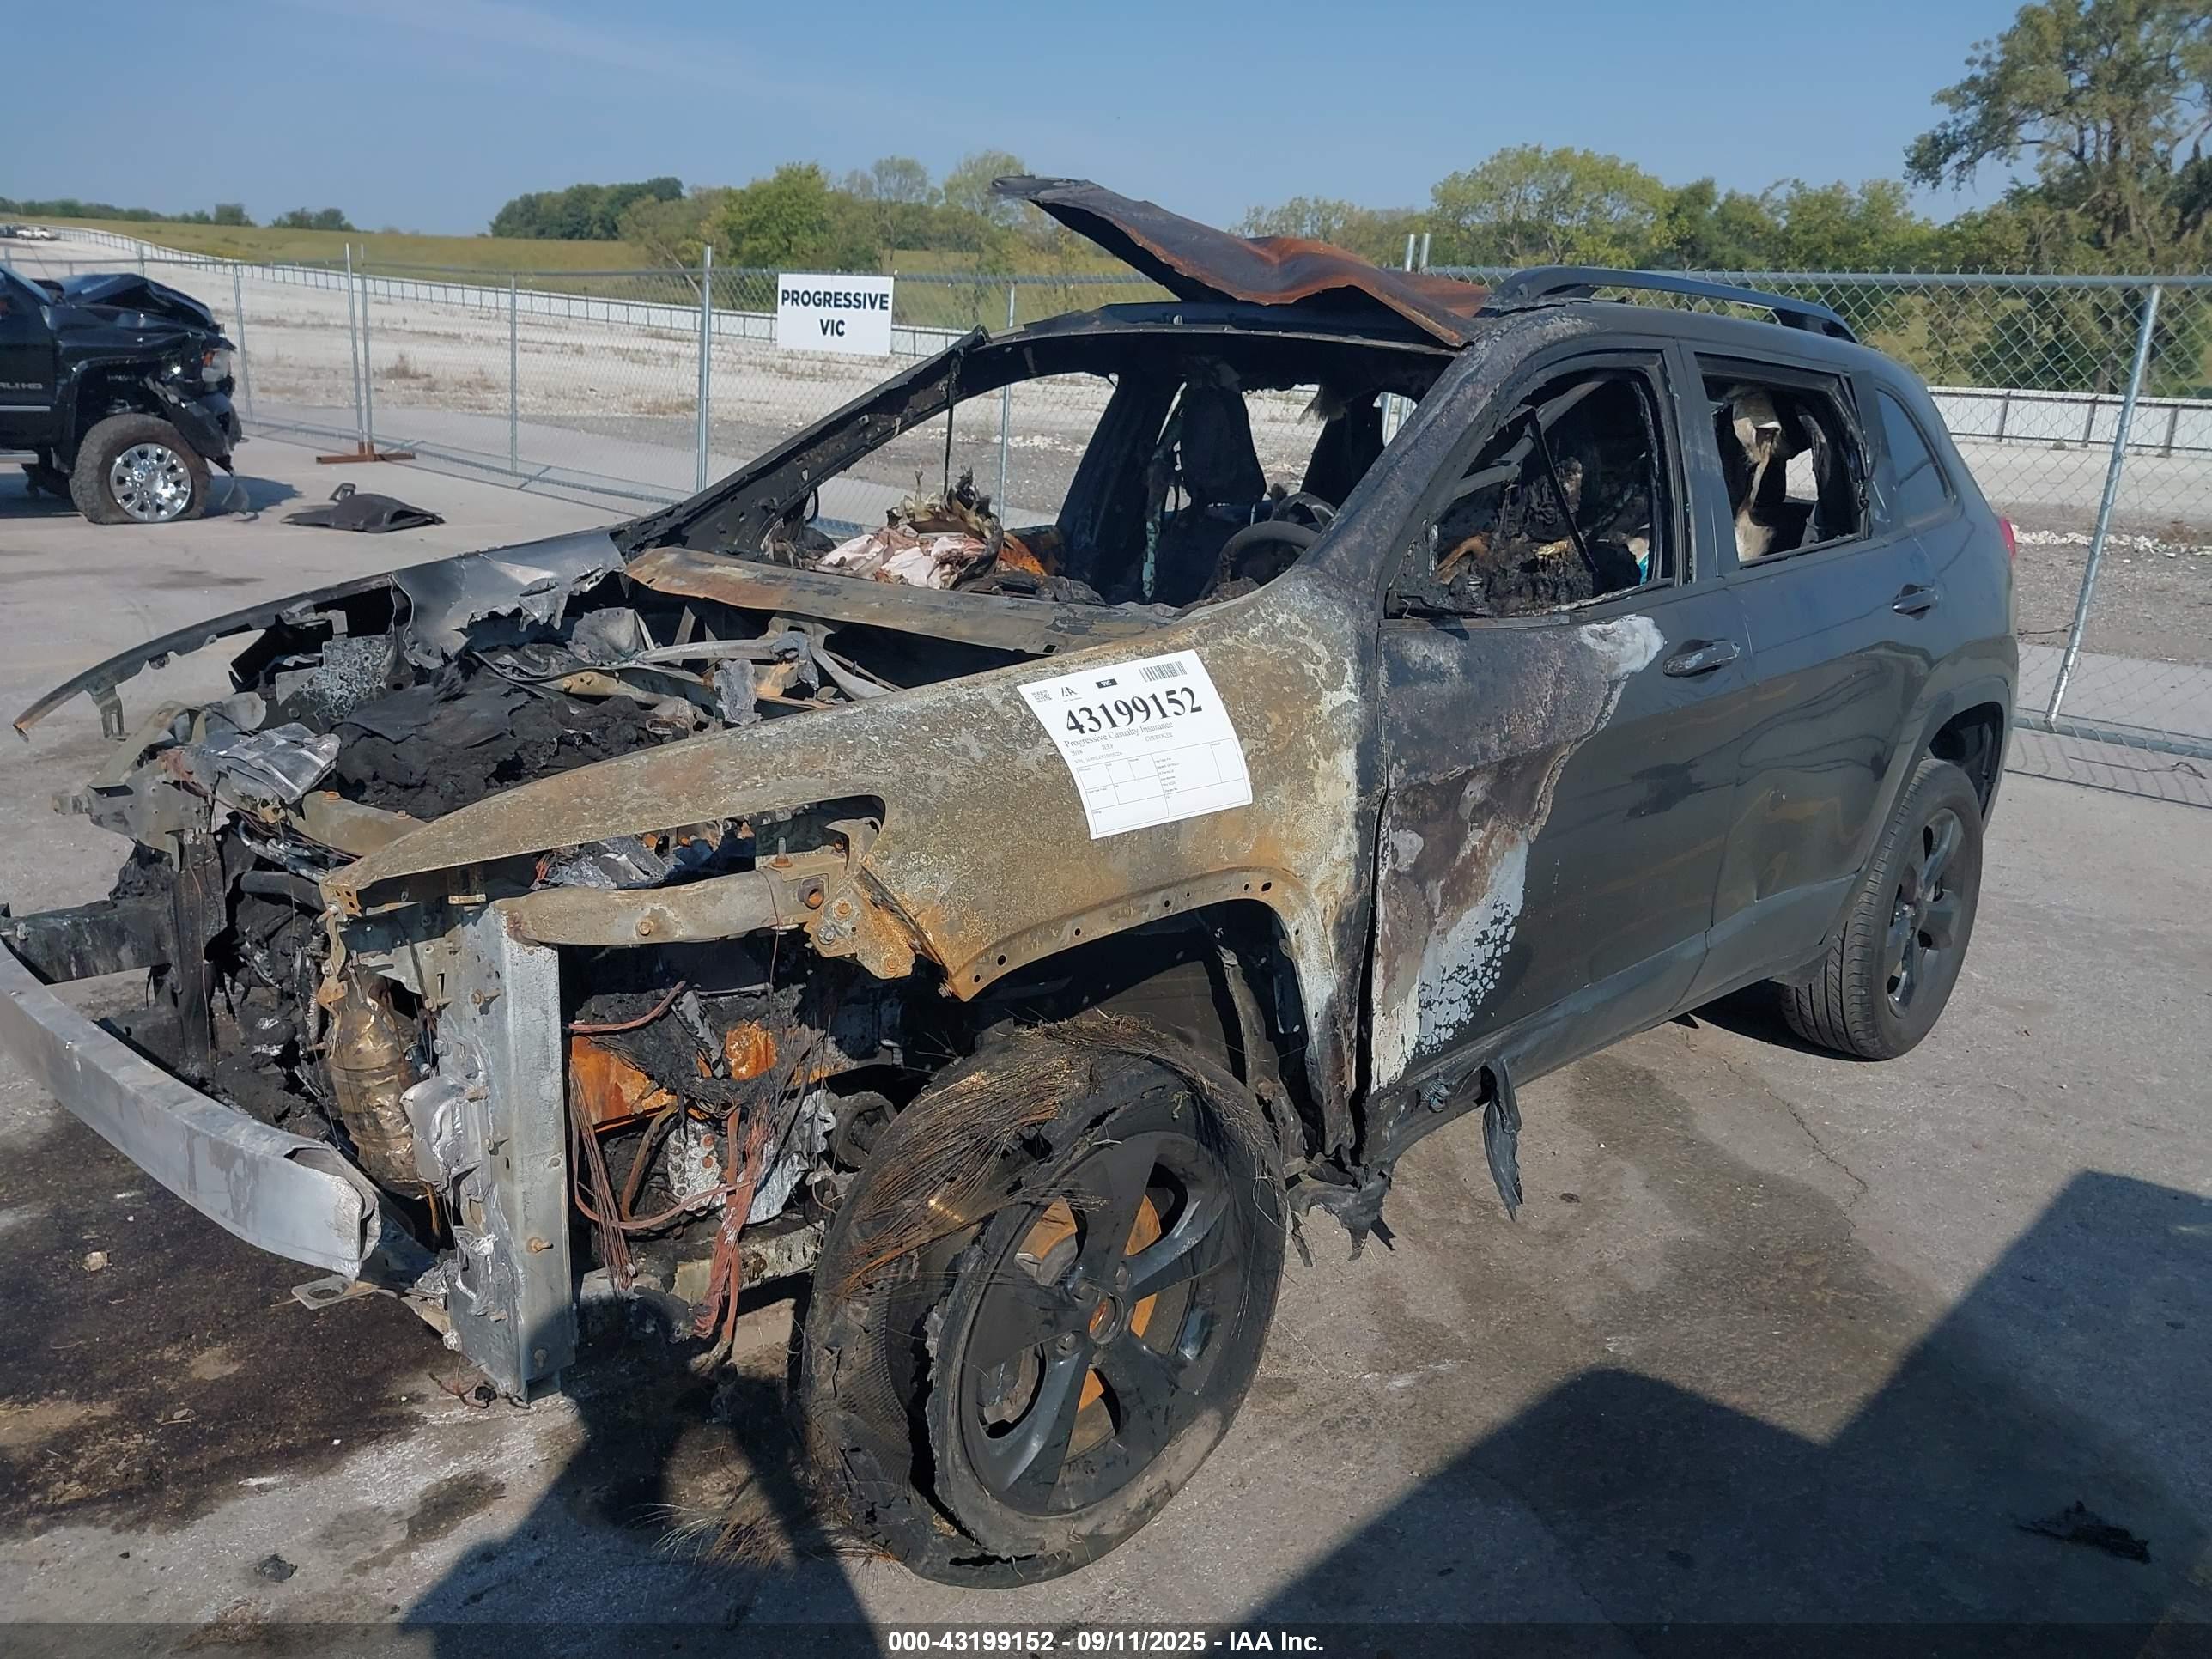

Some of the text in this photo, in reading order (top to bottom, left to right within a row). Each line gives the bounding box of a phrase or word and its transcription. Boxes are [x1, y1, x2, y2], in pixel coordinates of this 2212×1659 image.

[781, 289, 890, 311] PROGRESSIVE
[819, 319, 846, 337] VIC
[1066, 687, 1202, 734] 43199152
[1063, 721, 1174, 749] Progressive Casualty Insurance
